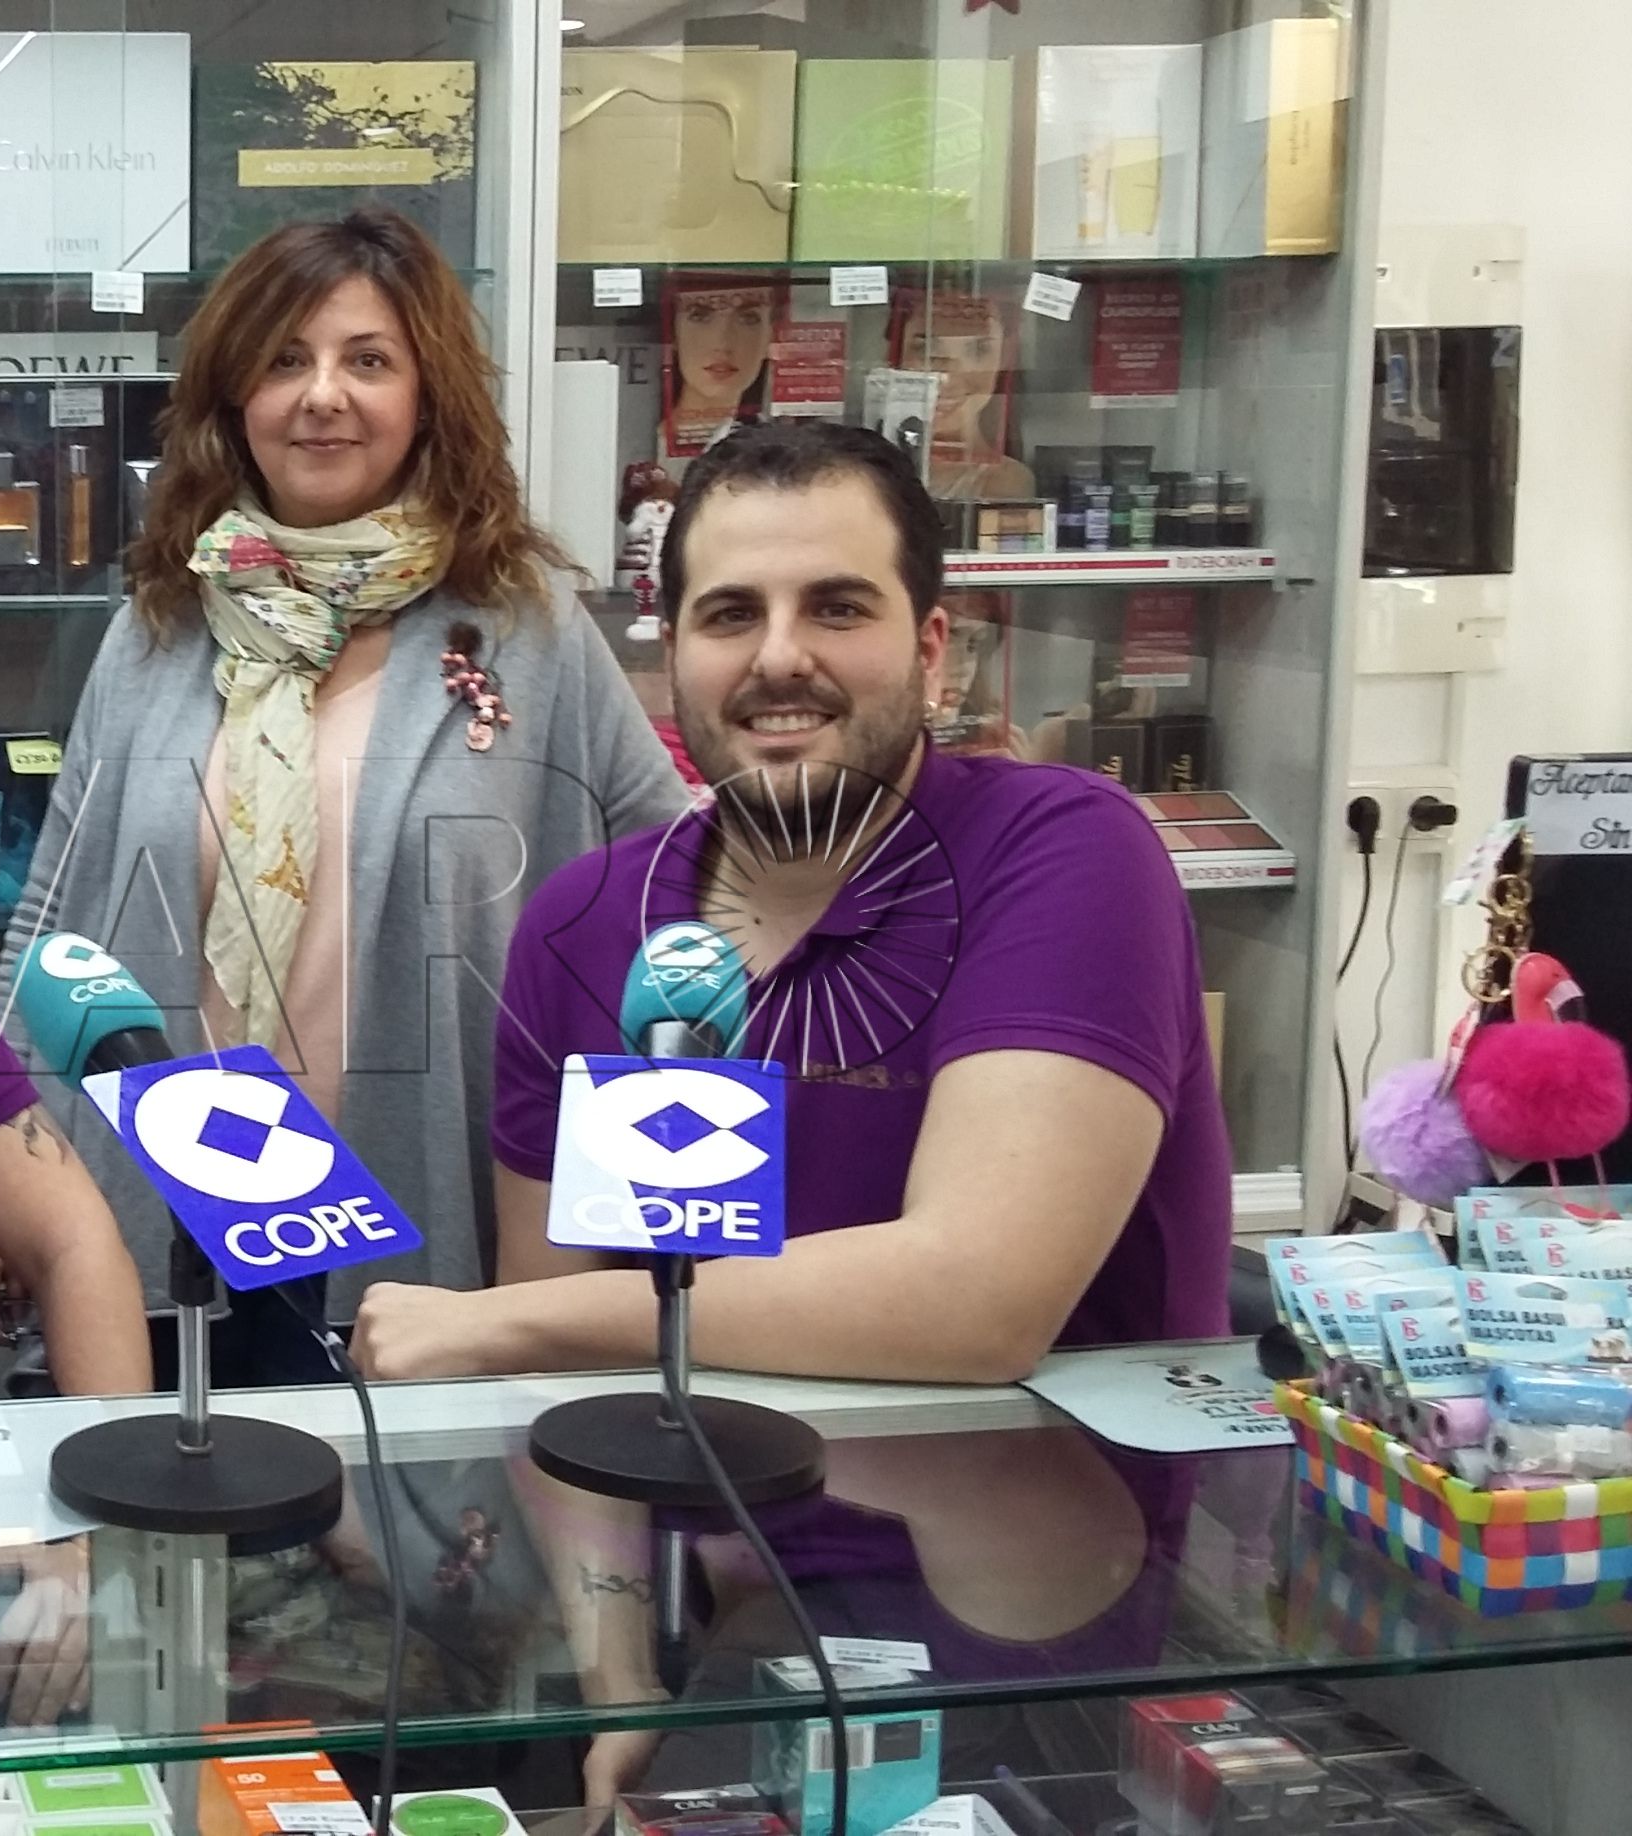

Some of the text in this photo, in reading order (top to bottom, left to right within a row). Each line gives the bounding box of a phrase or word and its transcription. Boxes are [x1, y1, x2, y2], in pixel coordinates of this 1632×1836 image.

[88, 142, 157, 172] Klein
[640, 967, 721, 989] COPE
[69, 976, 140, 1004] COPE
[572, 1195, 761, 1241] COPE
[223, 1196, 398, 1267] COPE
[1467, 1308, 1519, 1325] BOLSA
[1521, 1310, 1567, 1328] BASU
[1469, 1325, 1557, 1345] MASCOTAS
[1404, 1344, 1449, 1361] BOLSA
[236, 1772, 267, 1786] 50
[917, 1817, 962, 1830] Euros
